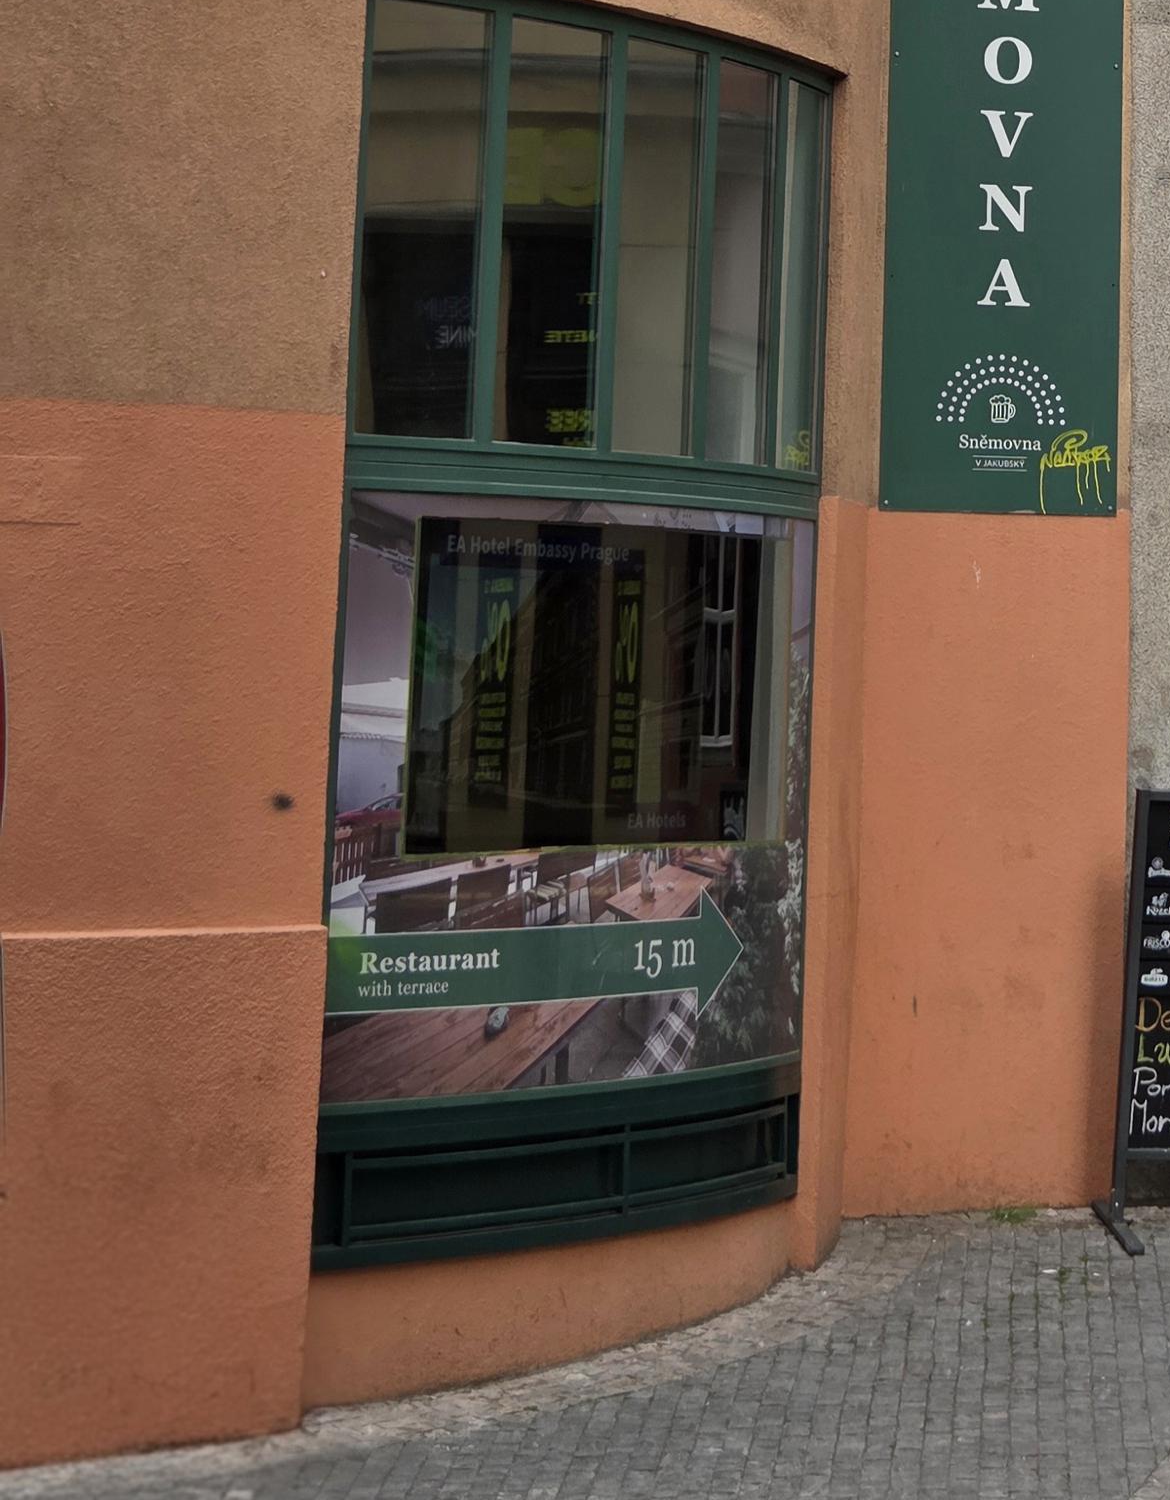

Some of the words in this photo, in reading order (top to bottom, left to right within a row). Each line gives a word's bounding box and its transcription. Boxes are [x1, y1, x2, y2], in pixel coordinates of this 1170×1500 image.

[959, 434, 1041, 451] Sněmovna
[471, 536, 510, 556] Hotel
[514, 538, 575, 563] Embassy
[580, 543, 630, 565] Prague
[647, 810, 687, 829] Hotels
[359, 948, 500, 975] Restaurant
[633, 939, 663, 978] 15
[672, 938, 696, 967] m
[358, 980, 392, 997] with
[398, 981, 449, 996] terrace
